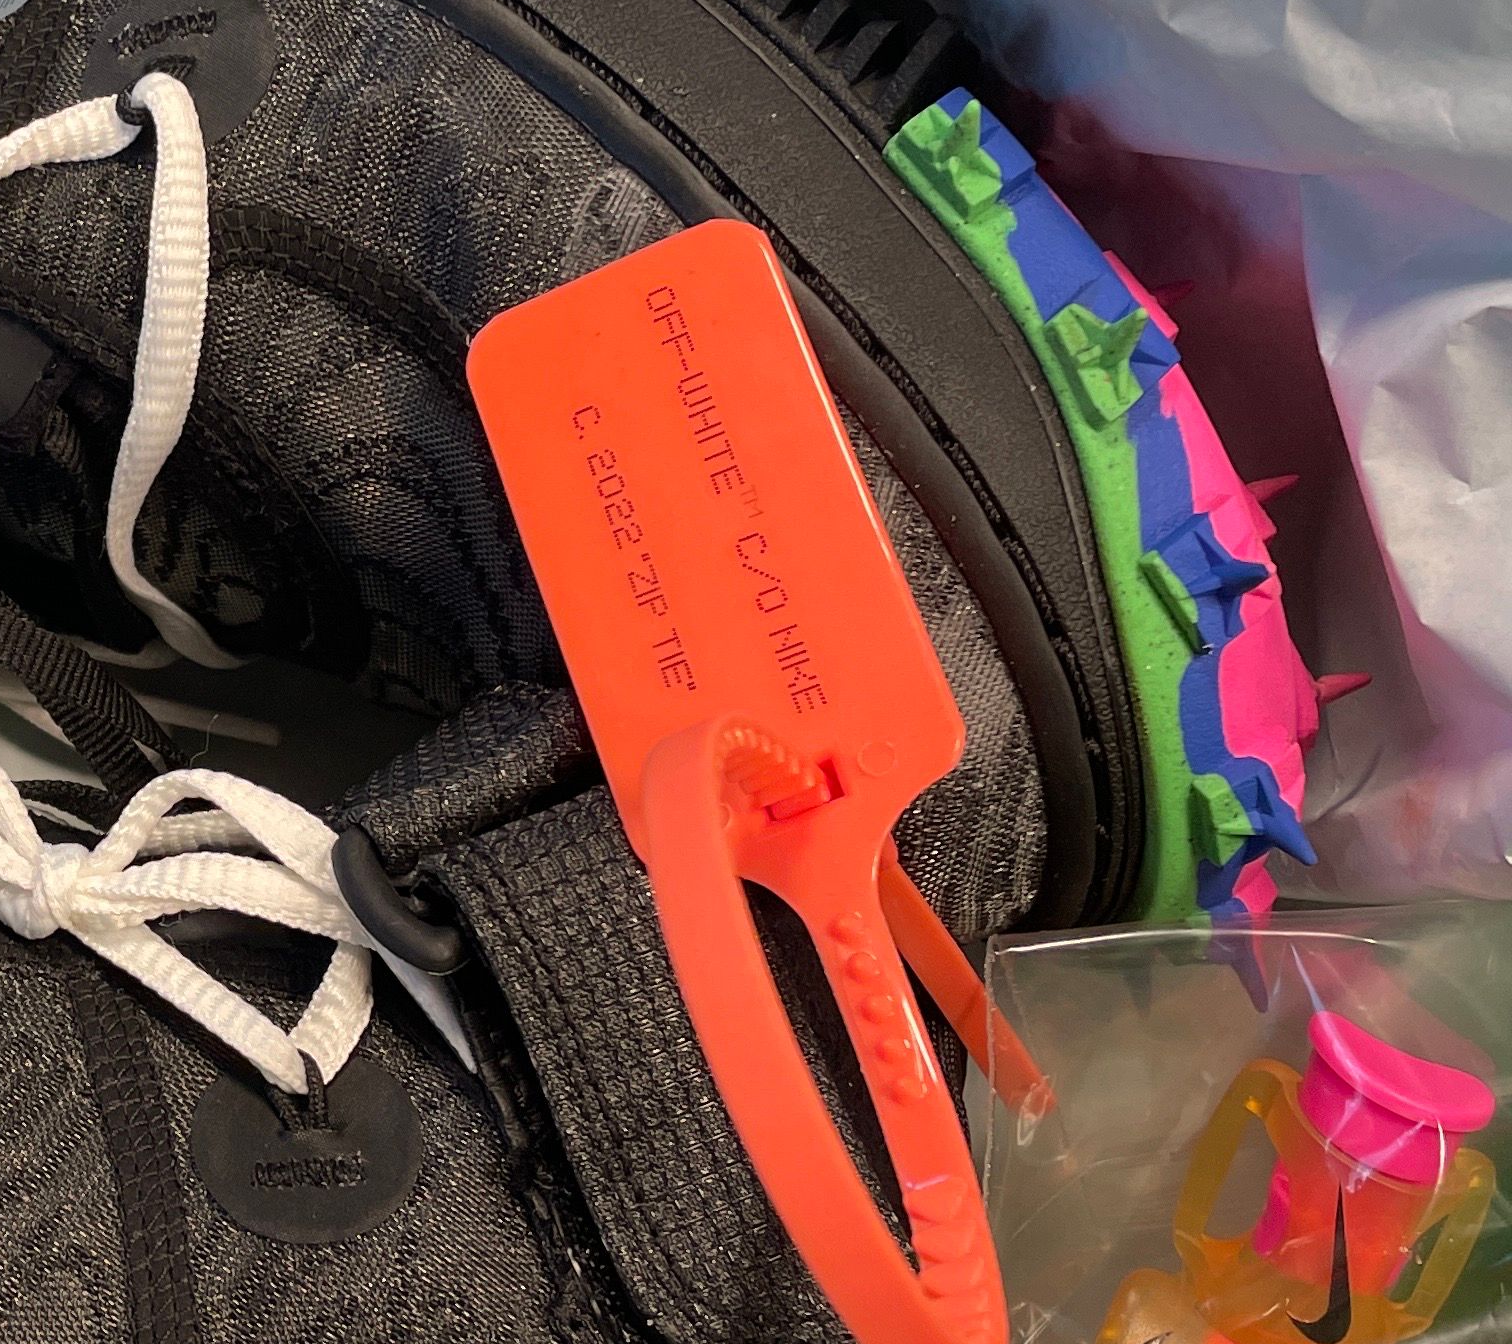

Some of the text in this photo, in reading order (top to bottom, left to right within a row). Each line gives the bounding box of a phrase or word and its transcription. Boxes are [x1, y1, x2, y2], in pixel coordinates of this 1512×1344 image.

[572, 404, 697, 690] C. 2022 "ZIP TIE"
[735, 532, 788, 613] C/O
[768, 623, 828, 714] NIKE
